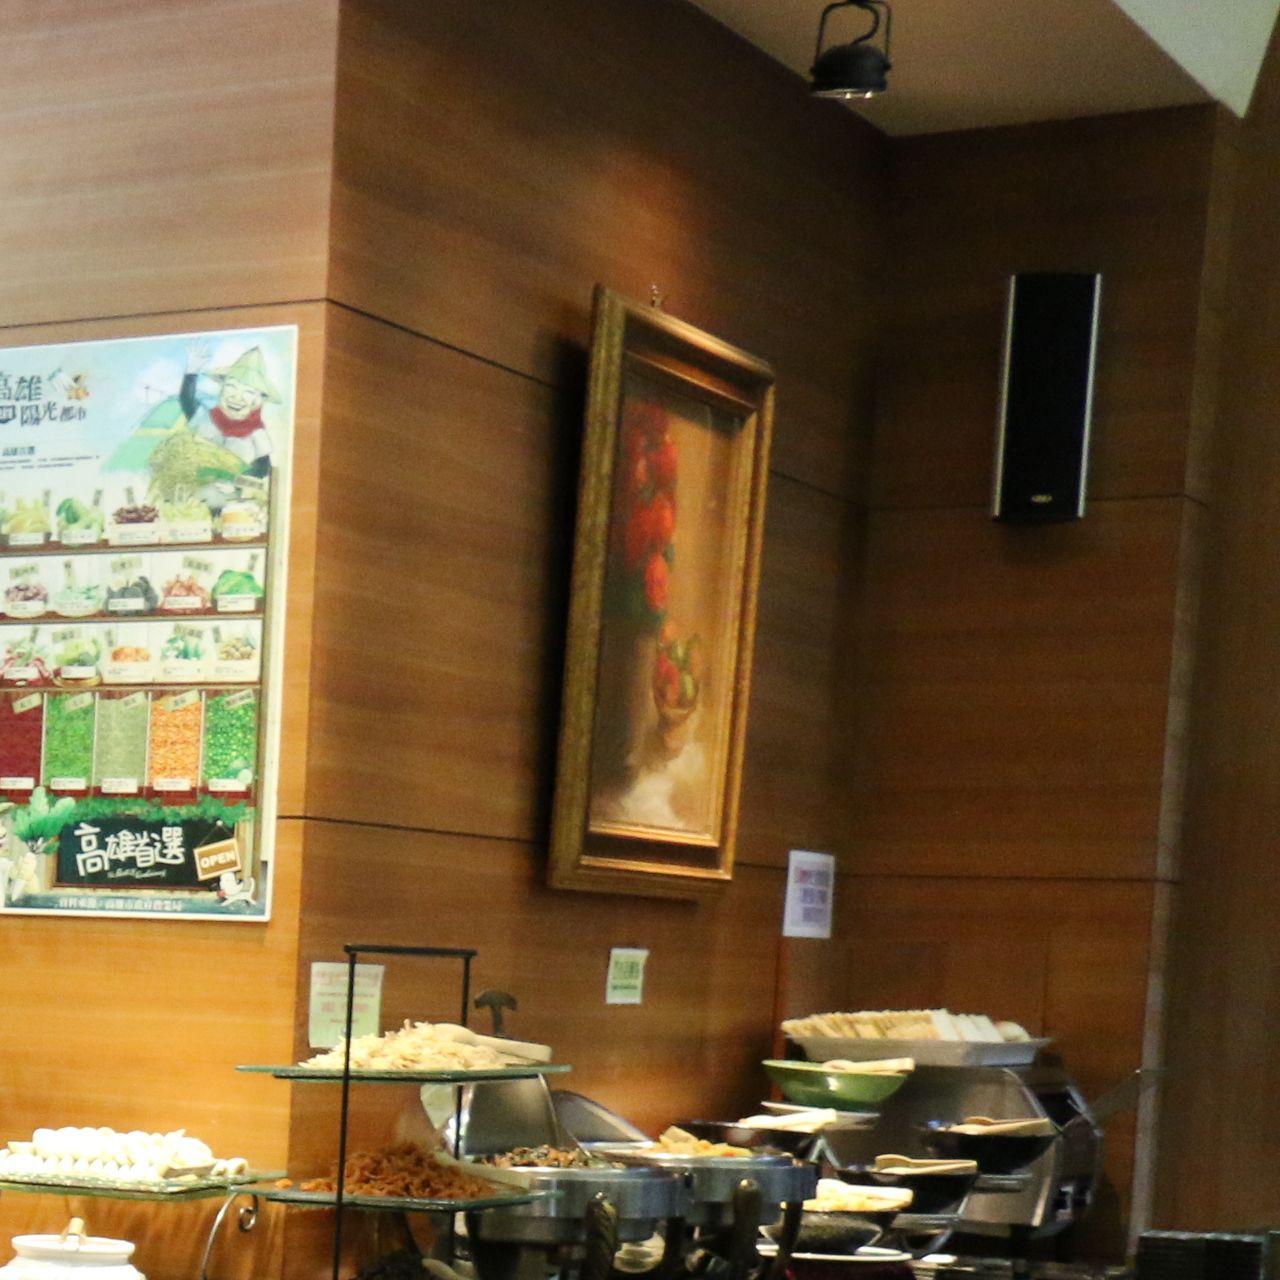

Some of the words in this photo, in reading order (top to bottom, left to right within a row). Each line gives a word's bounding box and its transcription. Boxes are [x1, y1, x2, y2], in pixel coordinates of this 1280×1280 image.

[74, 822, 185, 876] 高雄首選
[201, 851, 236, 868] OPEN
